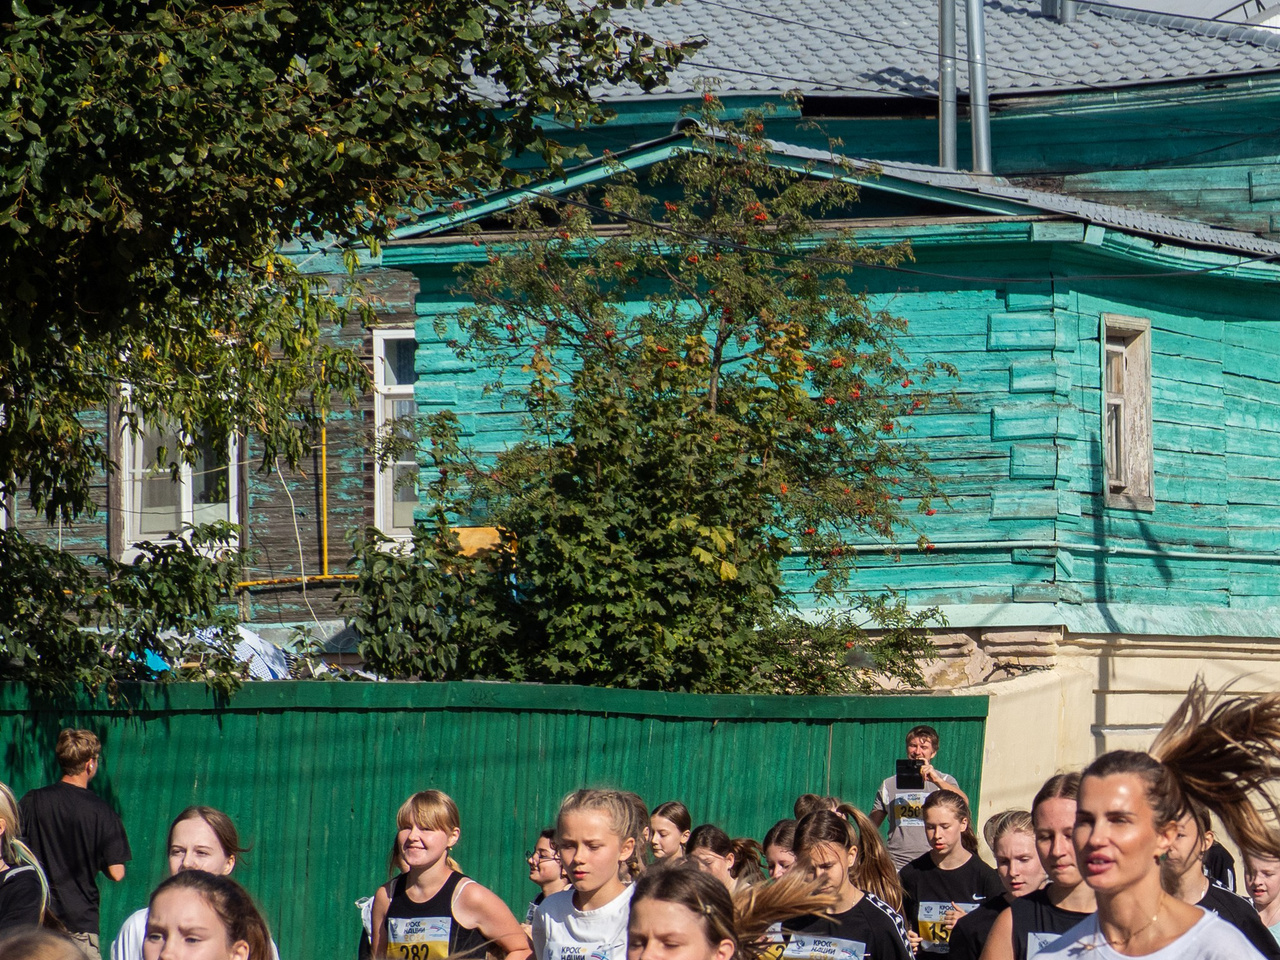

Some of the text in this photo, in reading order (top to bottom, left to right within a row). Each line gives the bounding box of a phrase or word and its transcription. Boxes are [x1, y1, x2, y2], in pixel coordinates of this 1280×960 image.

[900, 806, 921, 817] 250
[929, 923, 949, 940] 15
[813, 939, 832, 948] КРОСС
[561, 946, 581, 954] КРОСС
[811, 947, 836, 955] НАЦИИ
